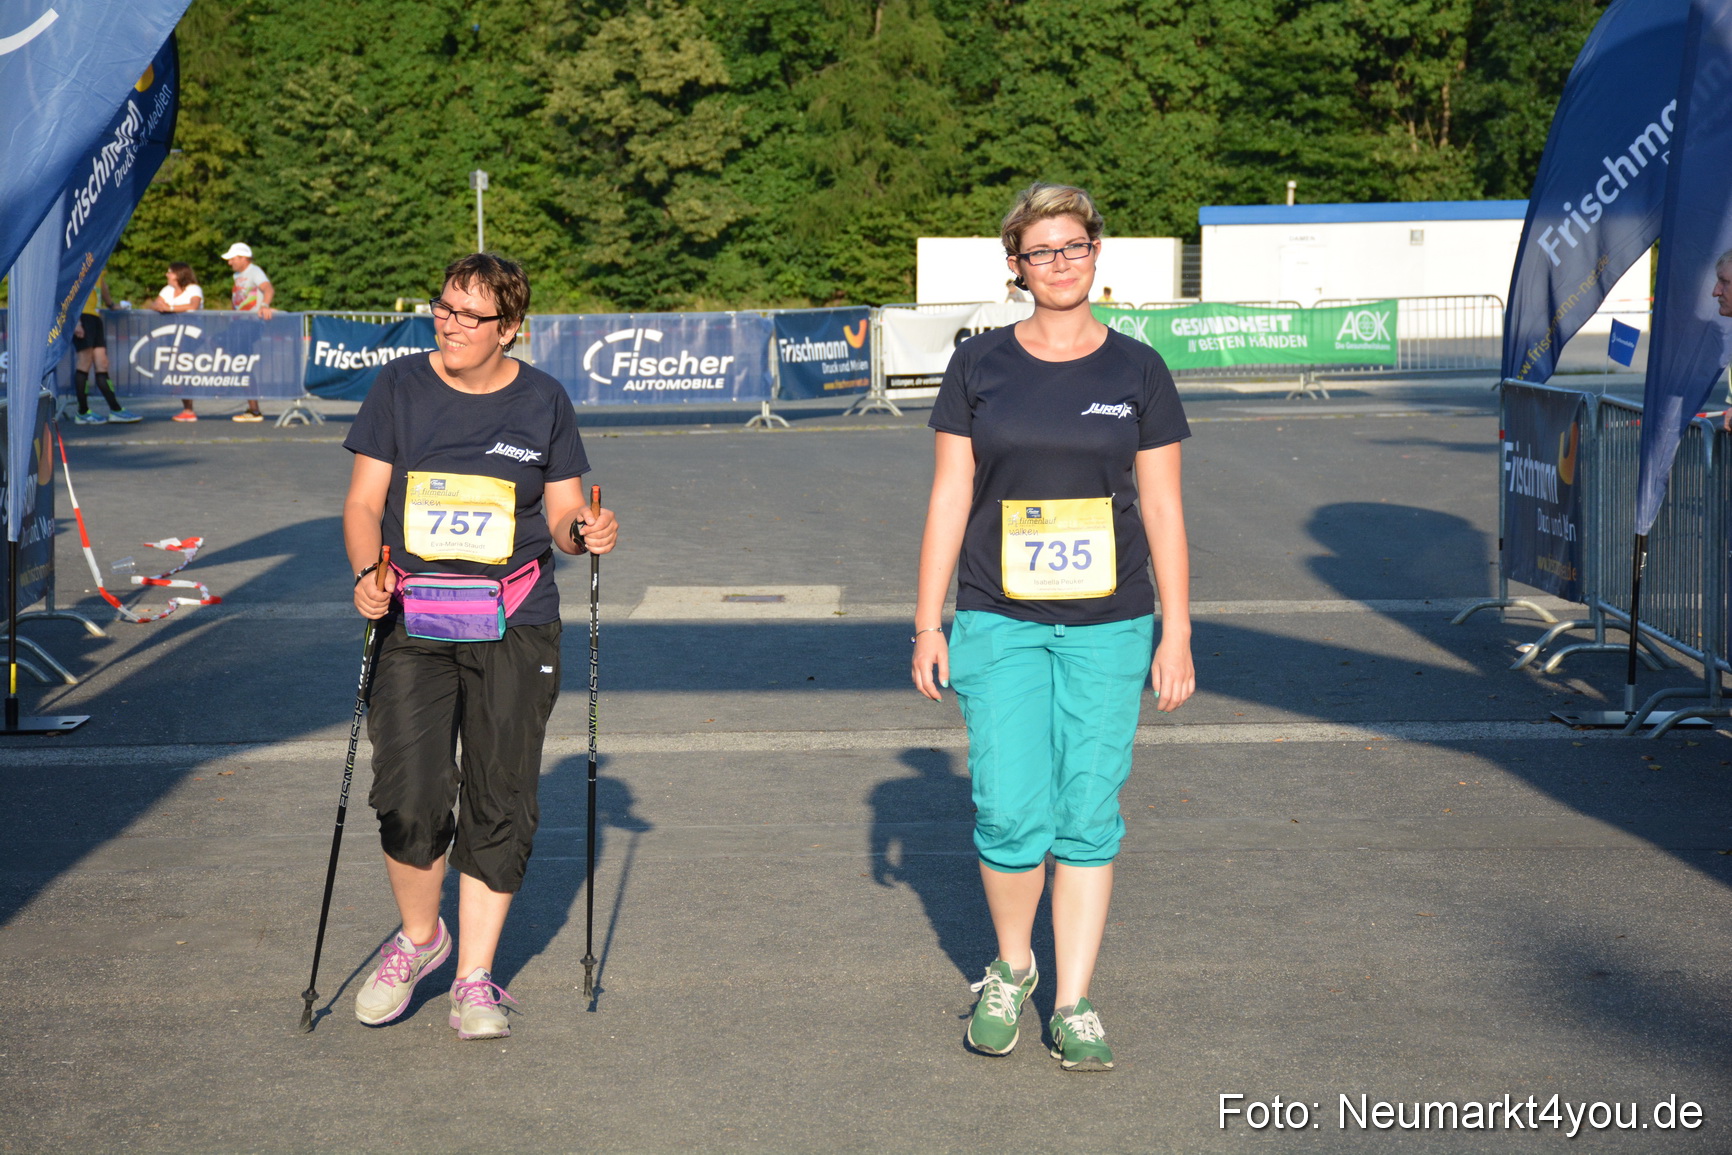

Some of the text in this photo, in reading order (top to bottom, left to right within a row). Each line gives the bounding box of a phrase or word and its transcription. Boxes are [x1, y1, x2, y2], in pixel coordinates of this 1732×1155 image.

[114, 145, 137, 188] Druck
[1171, 314, 1293, 336] GESUNDHEIT
[1336, 310, 1391, 342] AOK
[779, 336, 849, 363] Frischmann
[1198, 335, 1246, 351] BESTEN
[1248, 333, 1308, 349] HÄNDEN
[154, 347, 260, 373] Fischer
[611, 350, 735, 377] Fischer
[162, 374, 250, 387] AUTOMOBILE
[623, 378, 725, 391] AUTOMOBILE
[427, 510, 493, 537] 757
[1025, 539, 1093, 571] 735
[1034, 578, 1060, 586] Isabella
